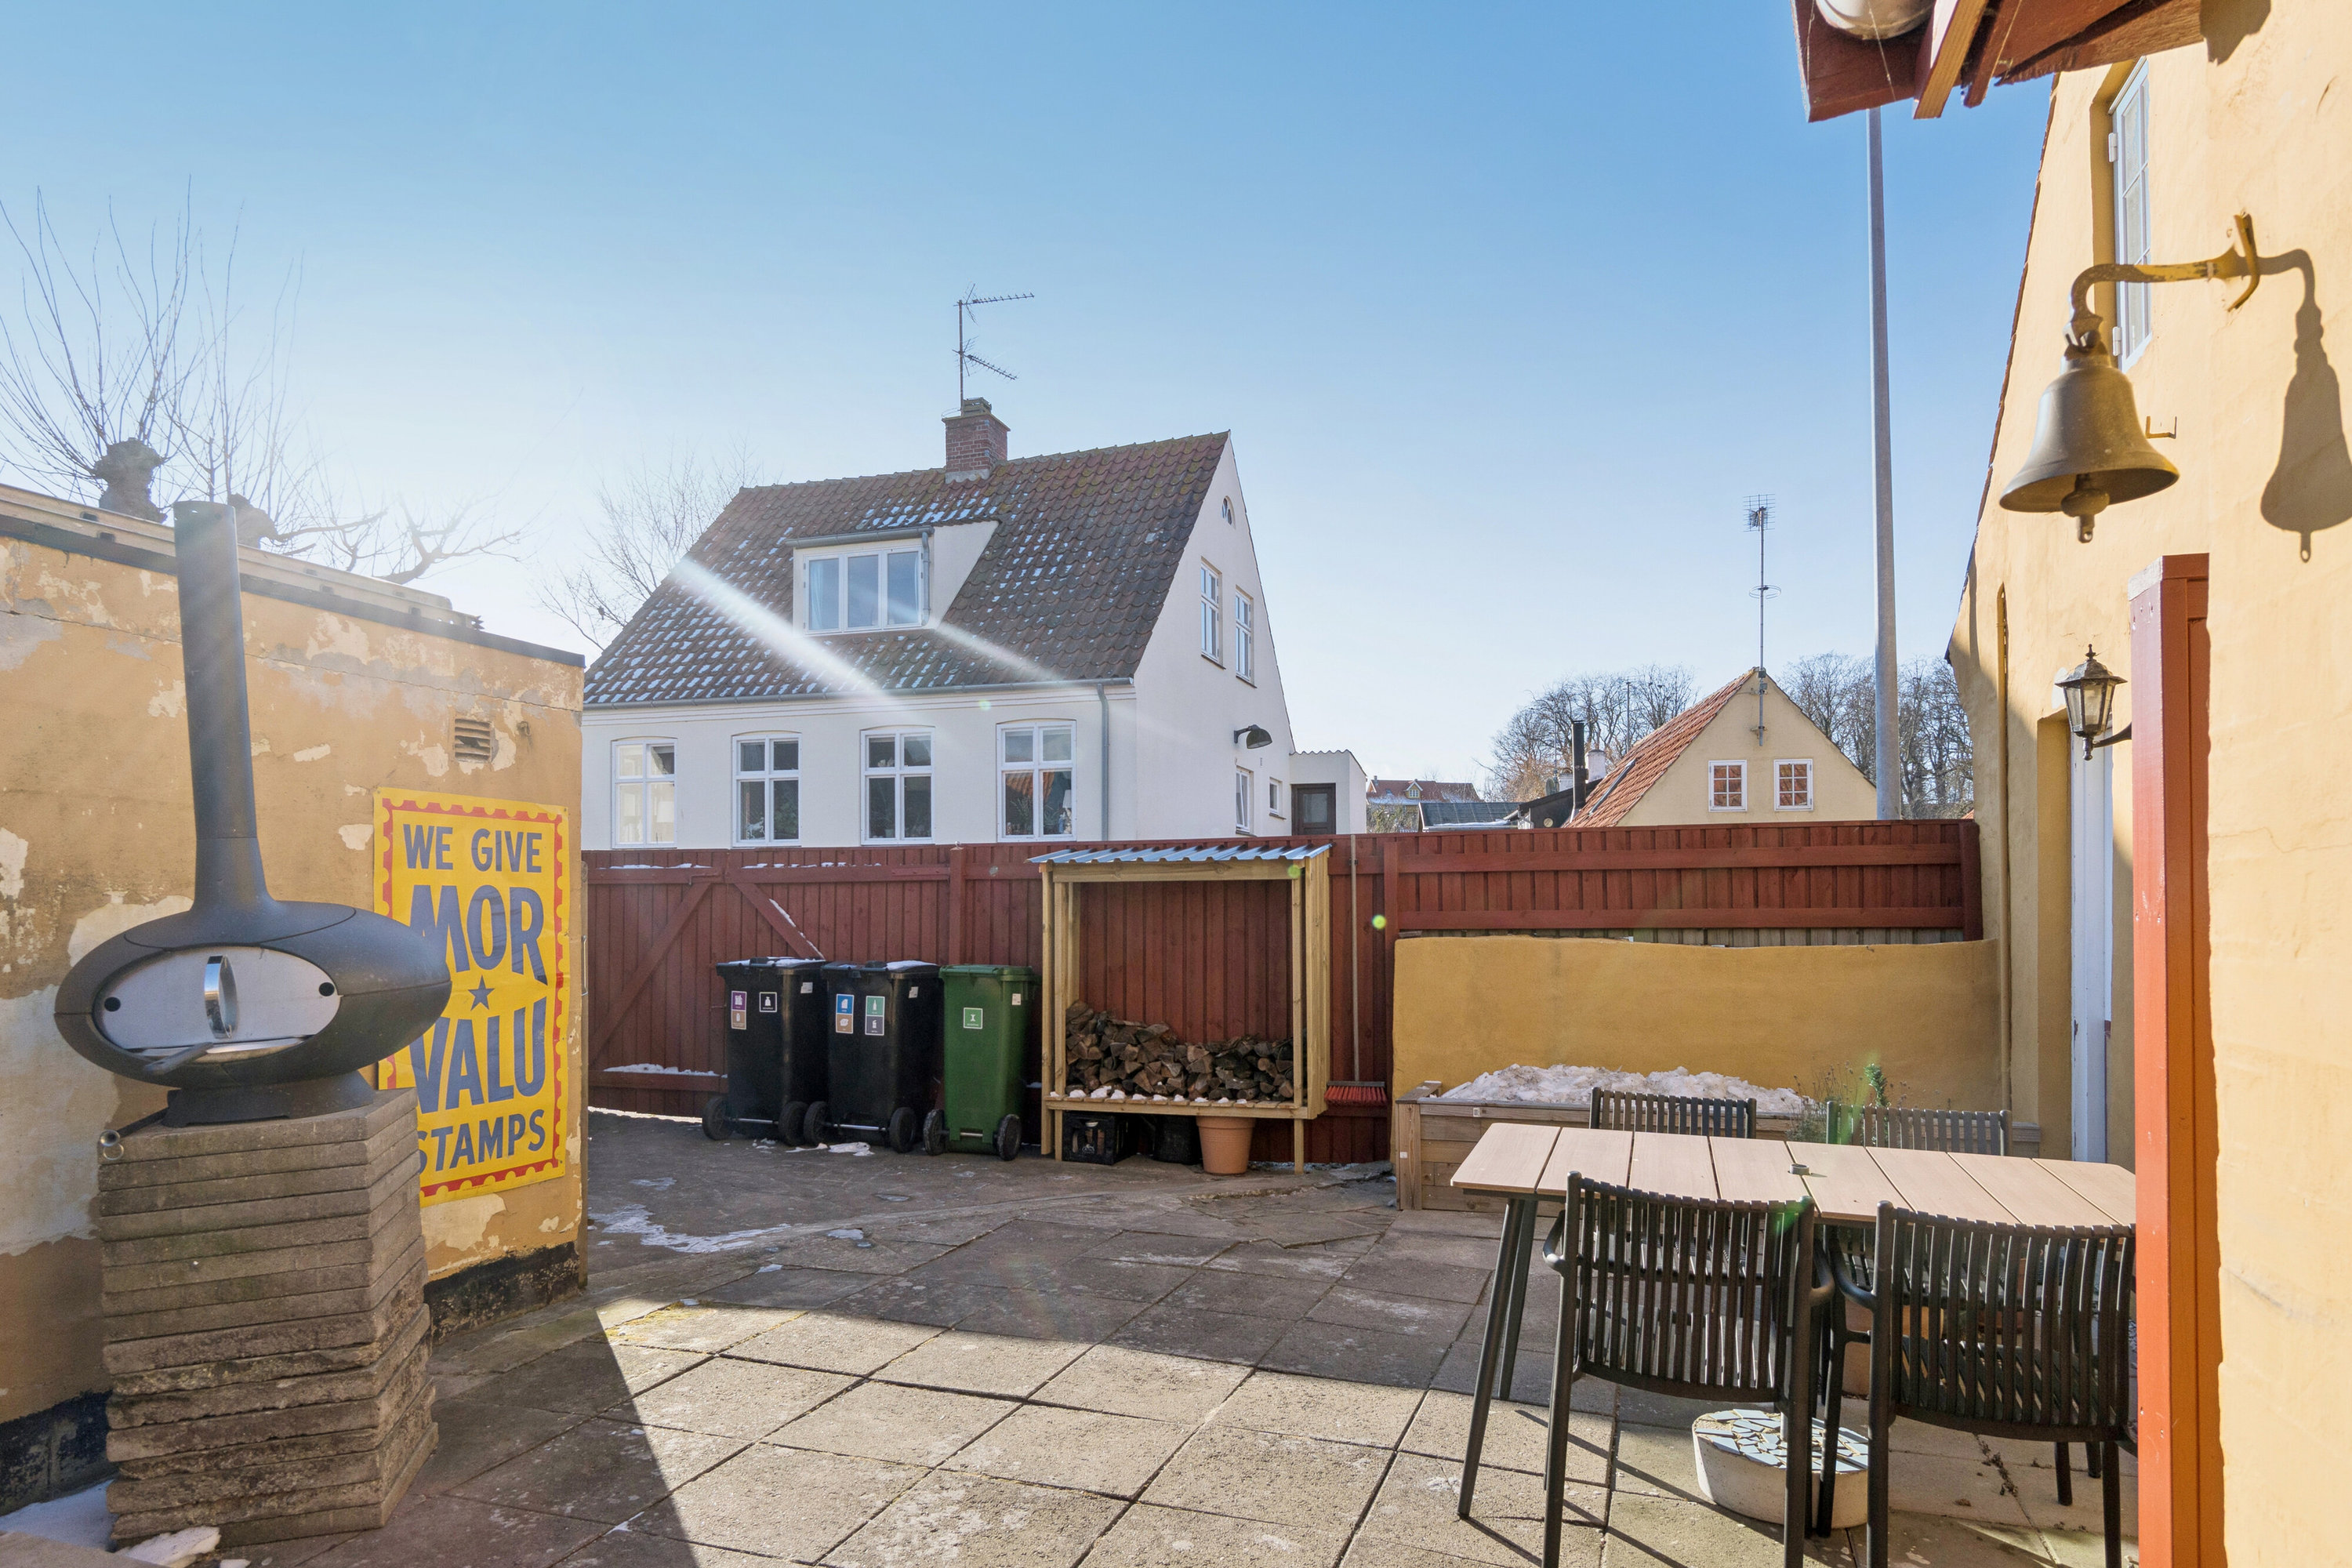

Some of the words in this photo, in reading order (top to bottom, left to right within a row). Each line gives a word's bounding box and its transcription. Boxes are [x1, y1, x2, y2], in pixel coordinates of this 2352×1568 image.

[403, 824, 453, 869] WE
[470, 828, 543, 873] GIVE
[409, 884, 548, 986] MOR
[408, 996, 547, 1114] VALU
